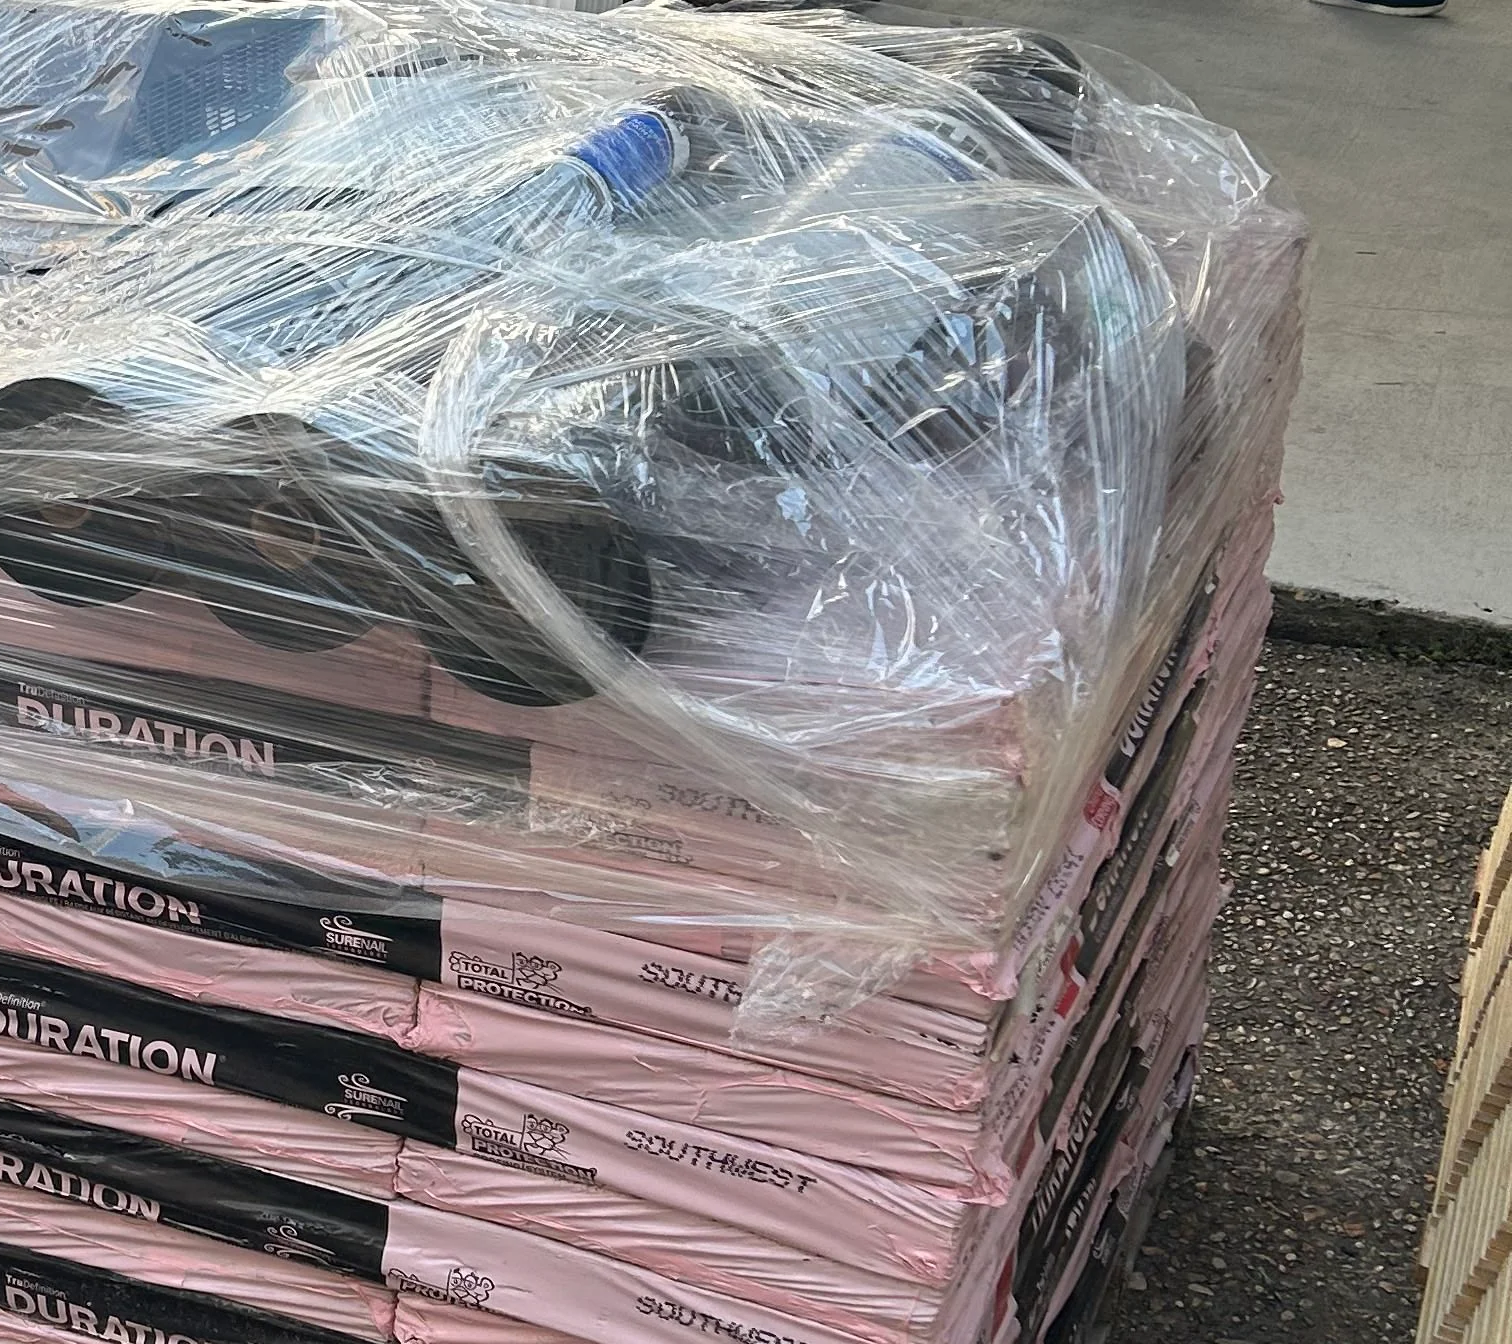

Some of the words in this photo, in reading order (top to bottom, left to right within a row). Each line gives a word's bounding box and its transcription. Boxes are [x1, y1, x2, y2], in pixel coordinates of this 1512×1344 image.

[17, 696, 276, 778] DURATION
[325, 932, 389, 955] SURENAIL
[460, 959, 508, 981] TOTAL
[459, 975, 591, 1016] PROTECTION
[344, 1088, 404, 1112] SURENAIL
[473, 1124, 518, 1147] TOTAL
[474, 1138, 595, 1179] PROTECTION
[624, 1130, 817, 1194] SOUTHWEST
[5, 1273, 67, 1298] TruDefinition
